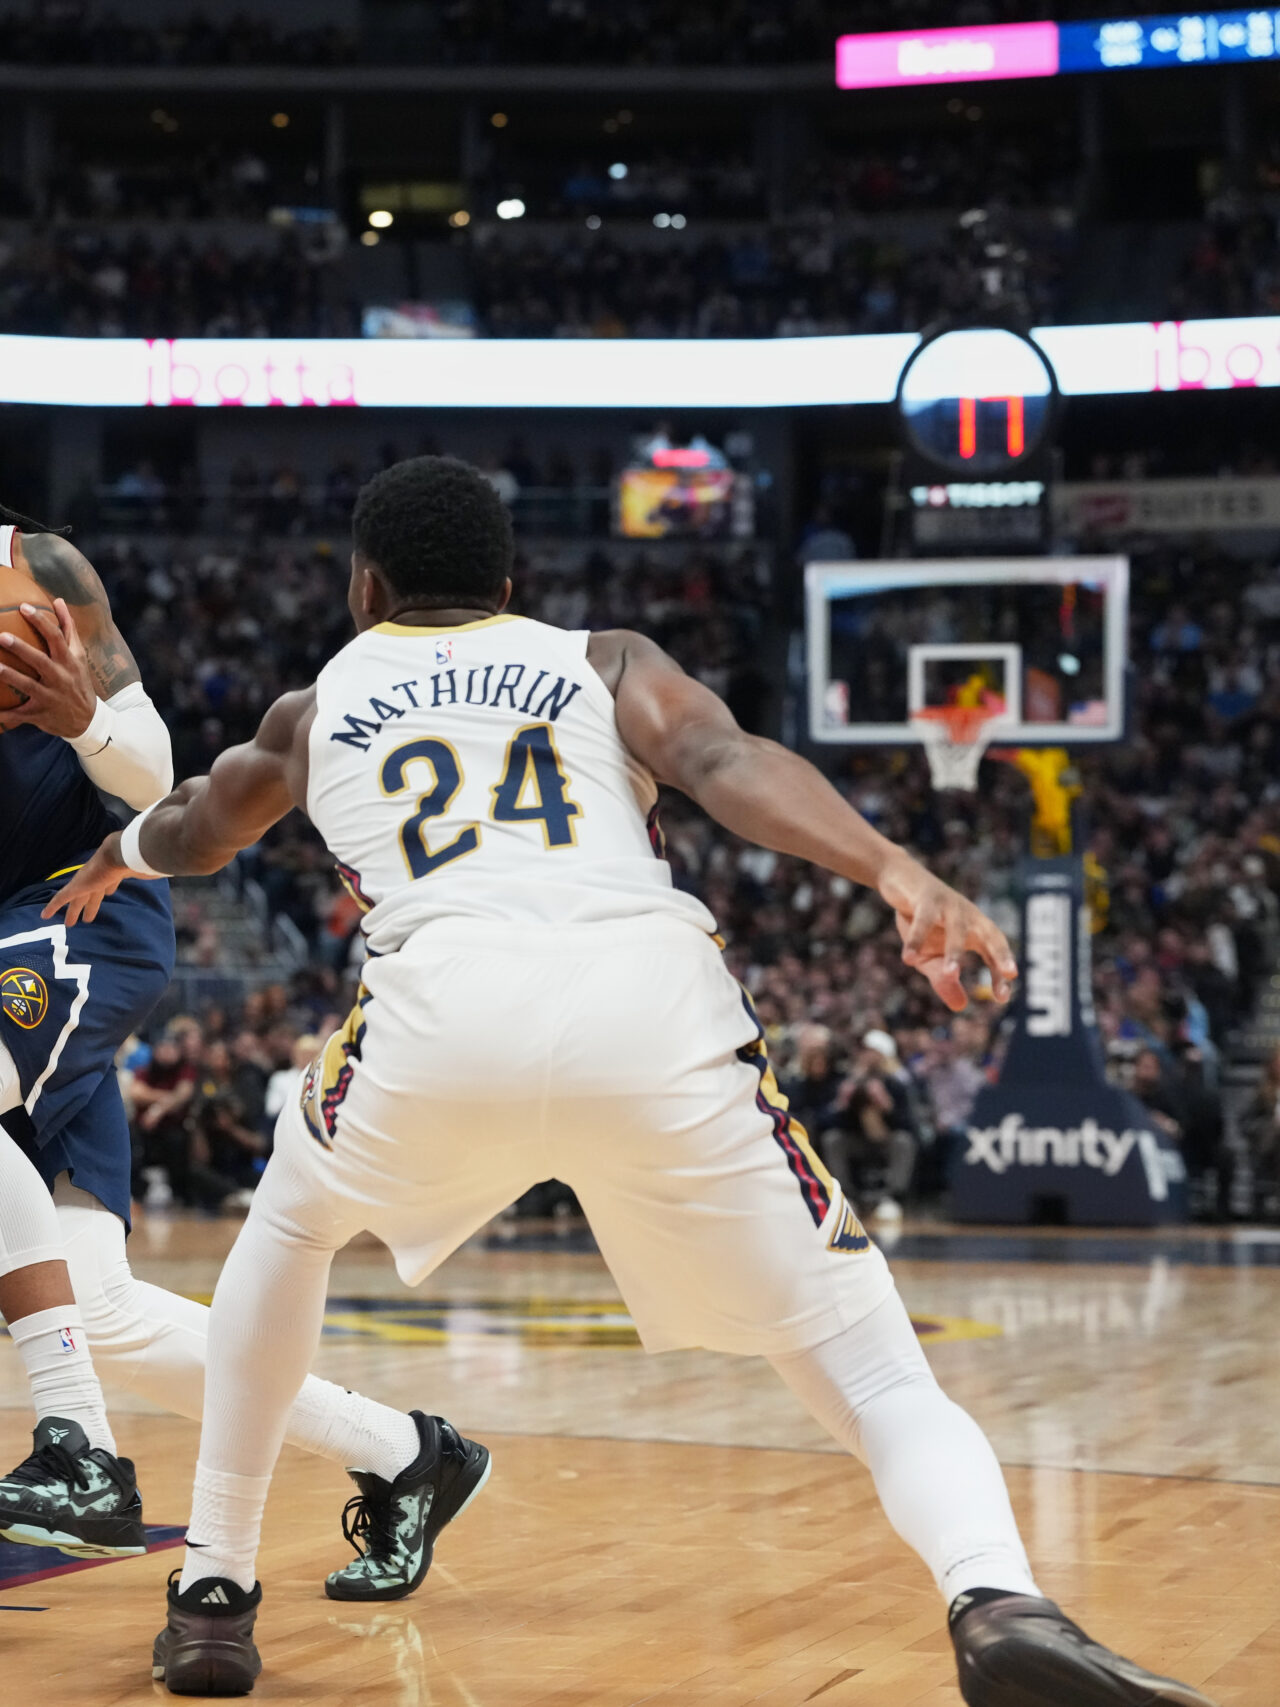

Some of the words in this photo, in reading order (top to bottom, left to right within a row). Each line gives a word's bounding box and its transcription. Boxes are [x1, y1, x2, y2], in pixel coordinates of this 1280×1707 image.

[1151, 320, 1280, 392] ibo
[330, 664, 582, 752] MATHURIN
[378, 721, 585, 882] 24
[965, 1113, 1138, 1176] xfinity
